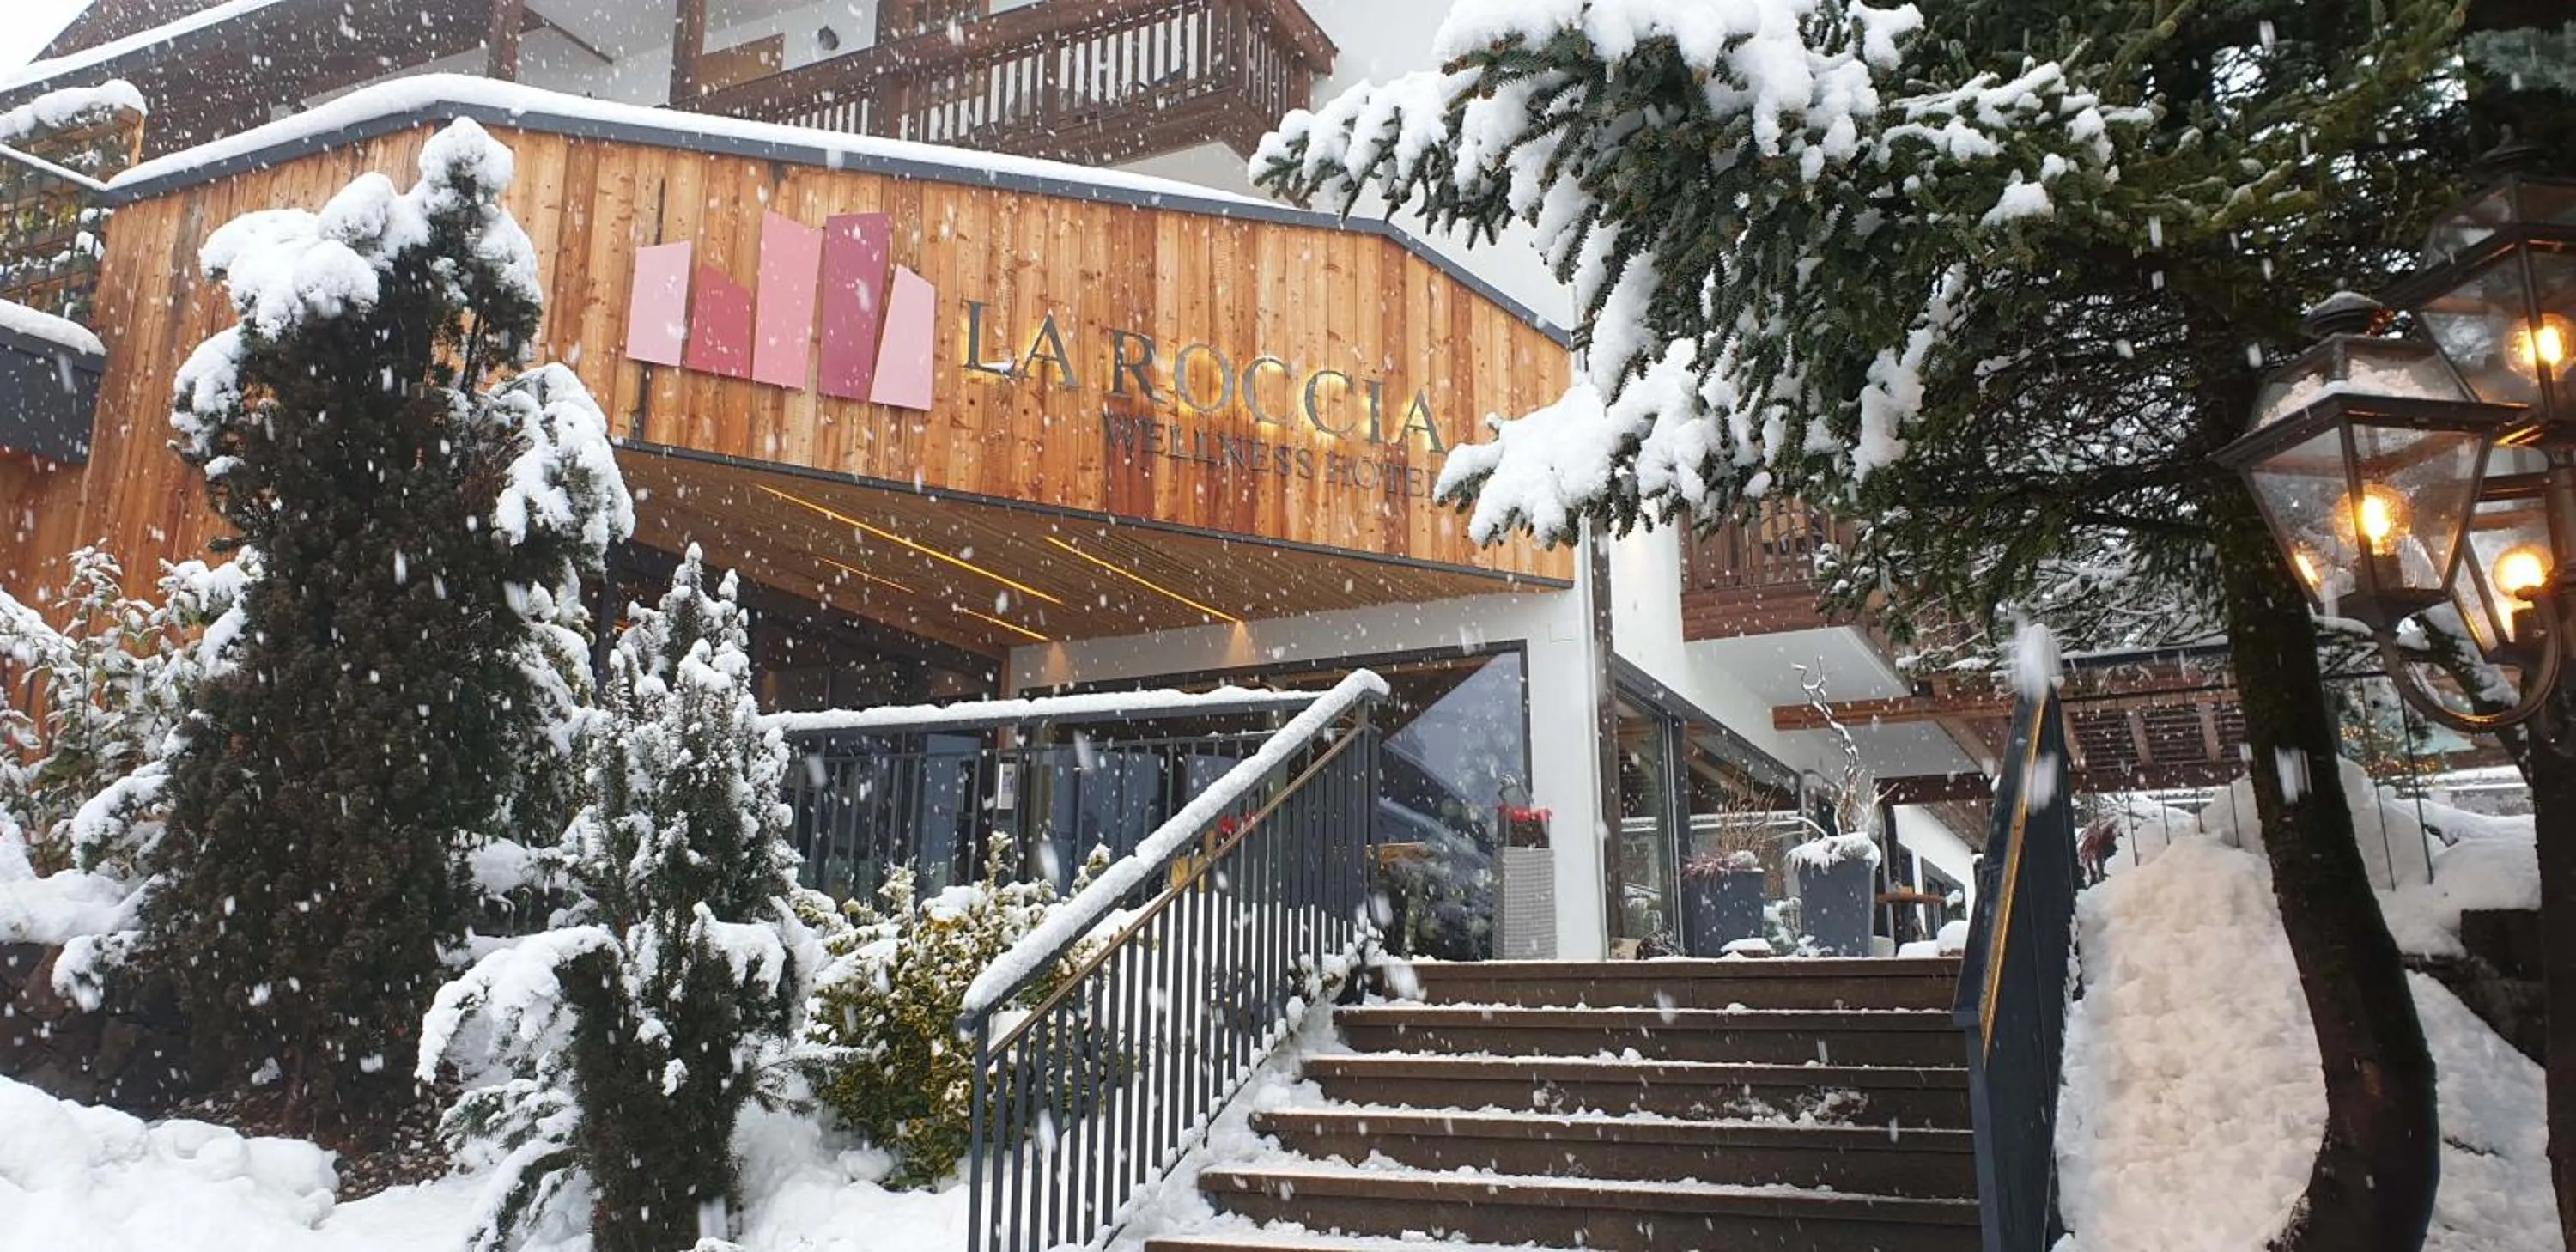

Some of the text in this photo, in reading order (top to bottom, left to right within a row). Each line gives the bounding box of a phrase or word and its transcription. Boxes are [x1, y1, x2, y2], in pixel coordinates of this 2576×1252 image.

[959, 300, 1448, 454] LA ROCCIA
[1103, 410, 1313, 479] WELLNESS
